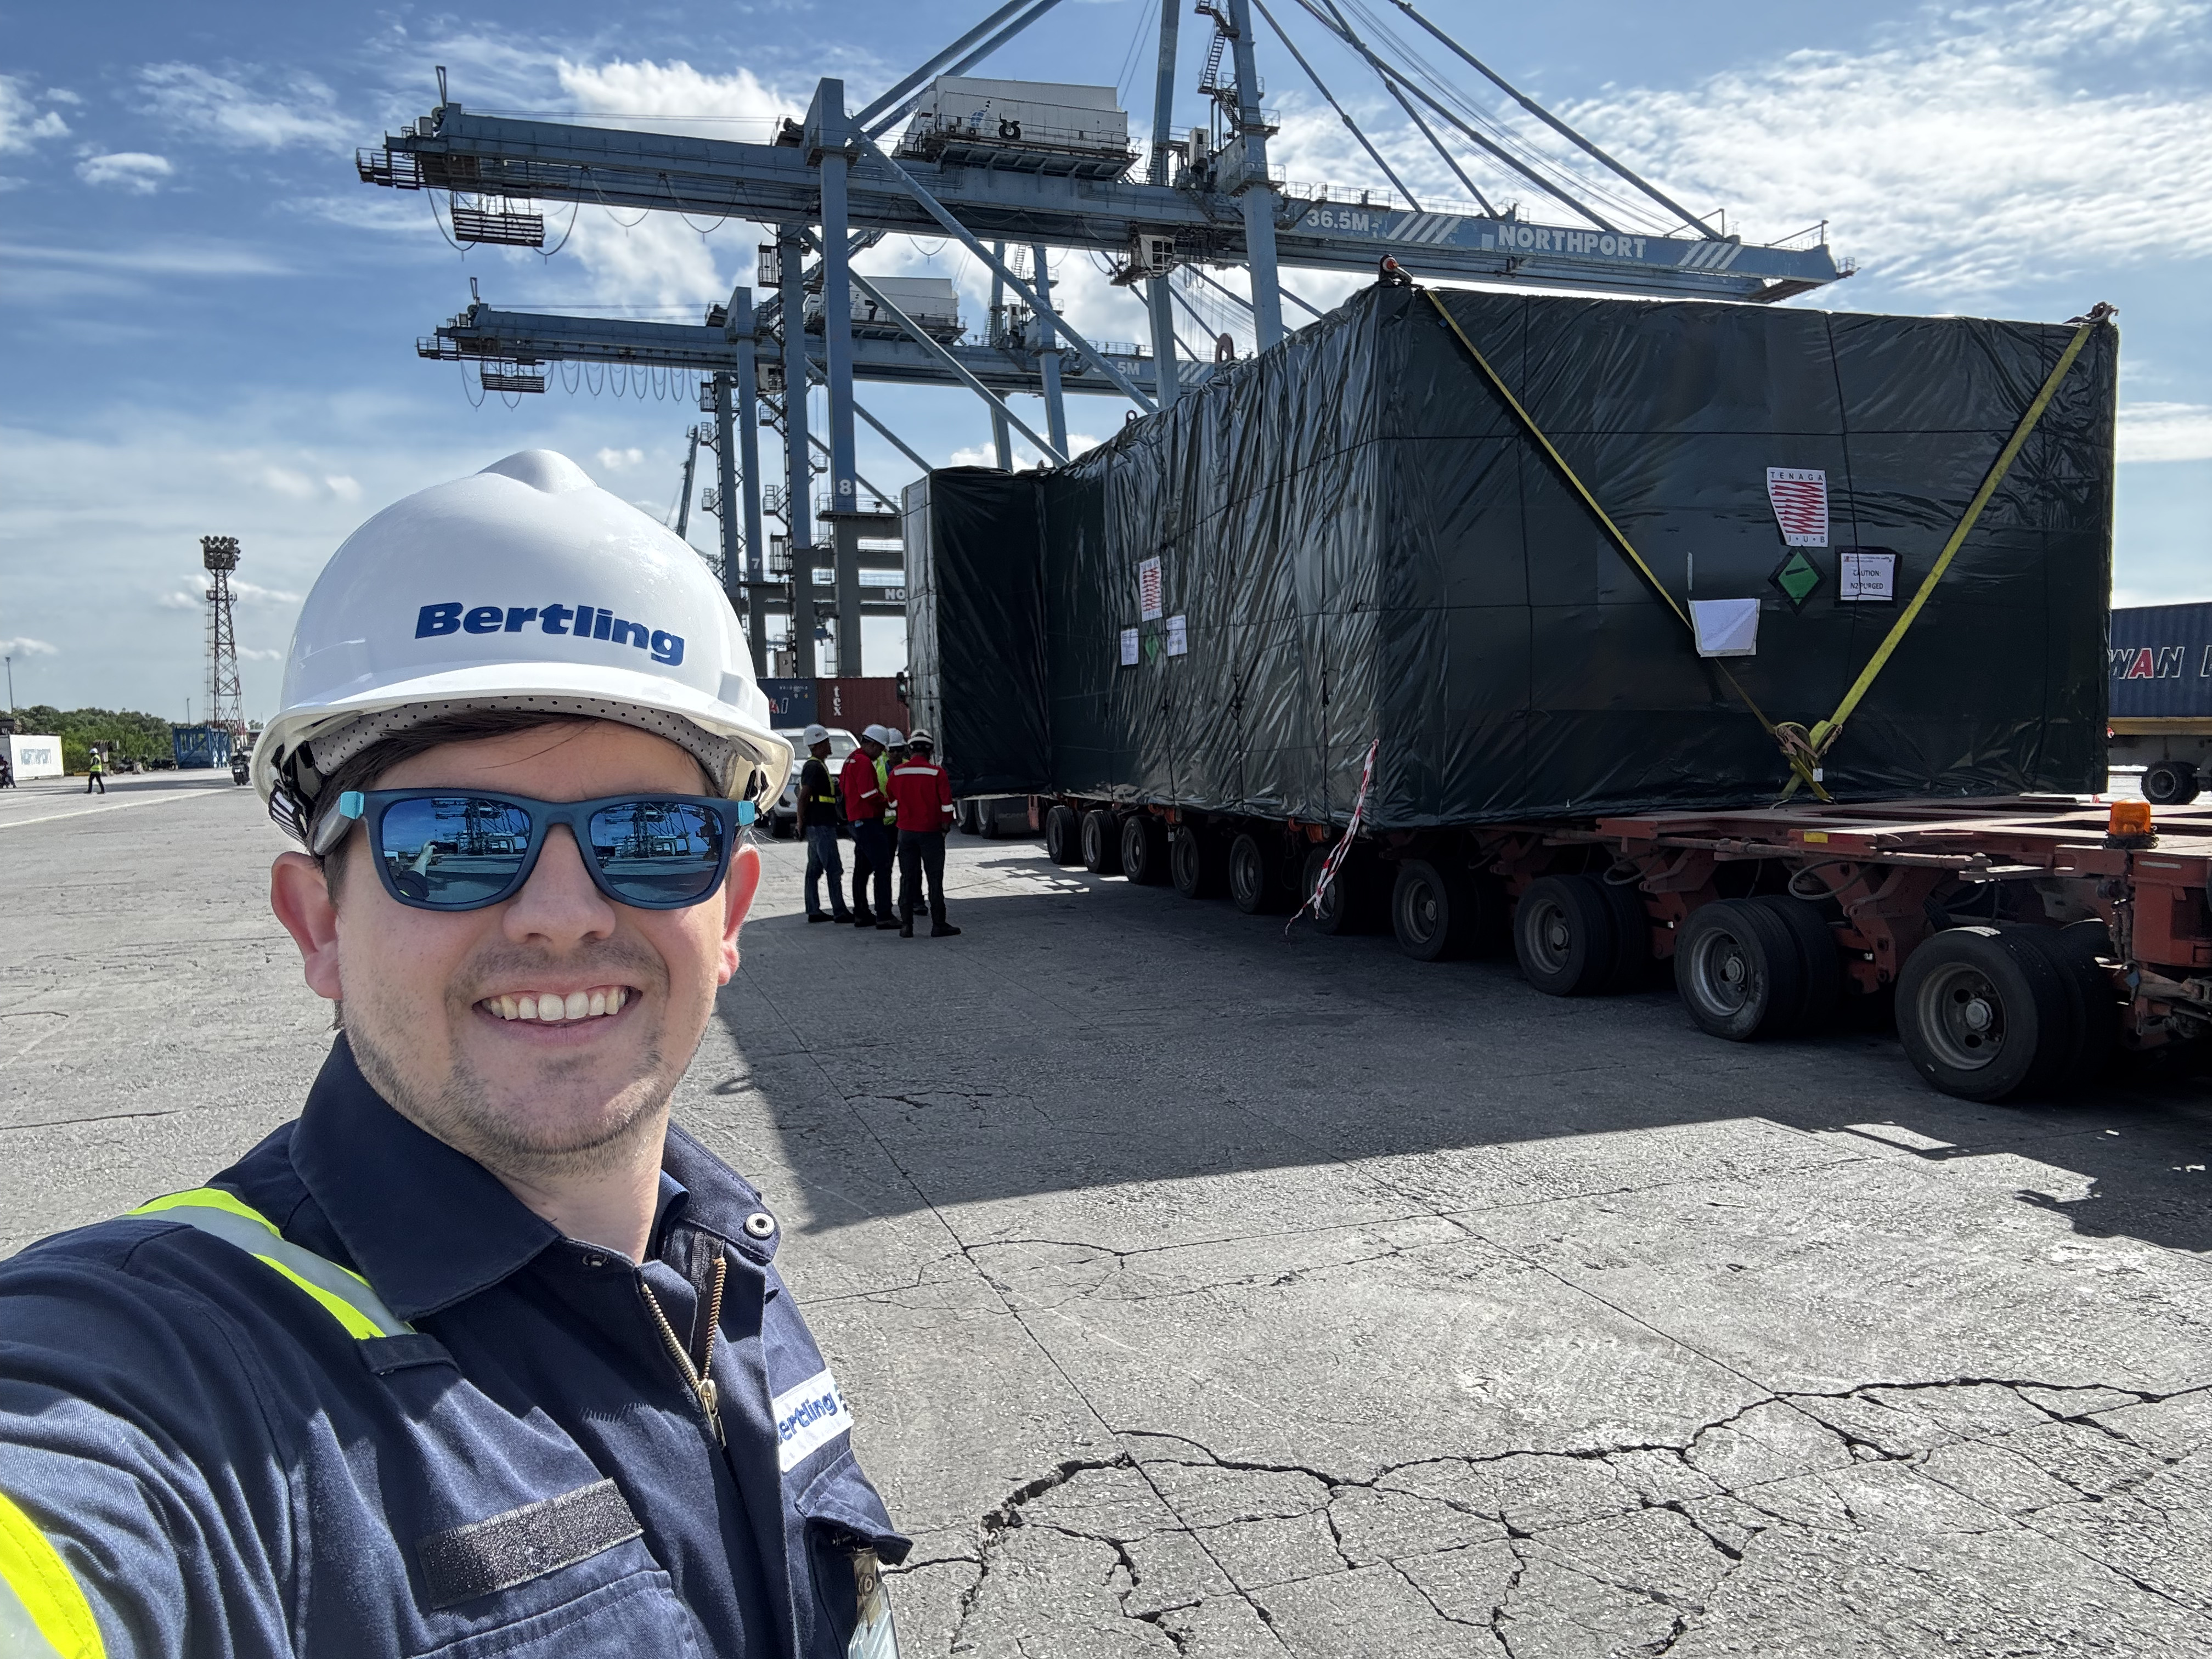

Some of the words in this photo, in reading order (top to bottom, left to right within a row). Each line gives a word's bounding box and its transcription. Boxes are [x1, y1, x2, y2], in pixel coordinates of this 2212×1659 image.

[1498, 225, 1646, 258] NORTHPORT
[865, 300, 878, 321] 7
[839, 479, 851, 495] 8
[1770, 472, 1824, 481] TENAGA
[751, 557, 760, 569] 7
[415, 602, 685, 666] Bertling
[2110, 646, 2186, 680] WAN
[777, 1392, 838, 1445] ertling
